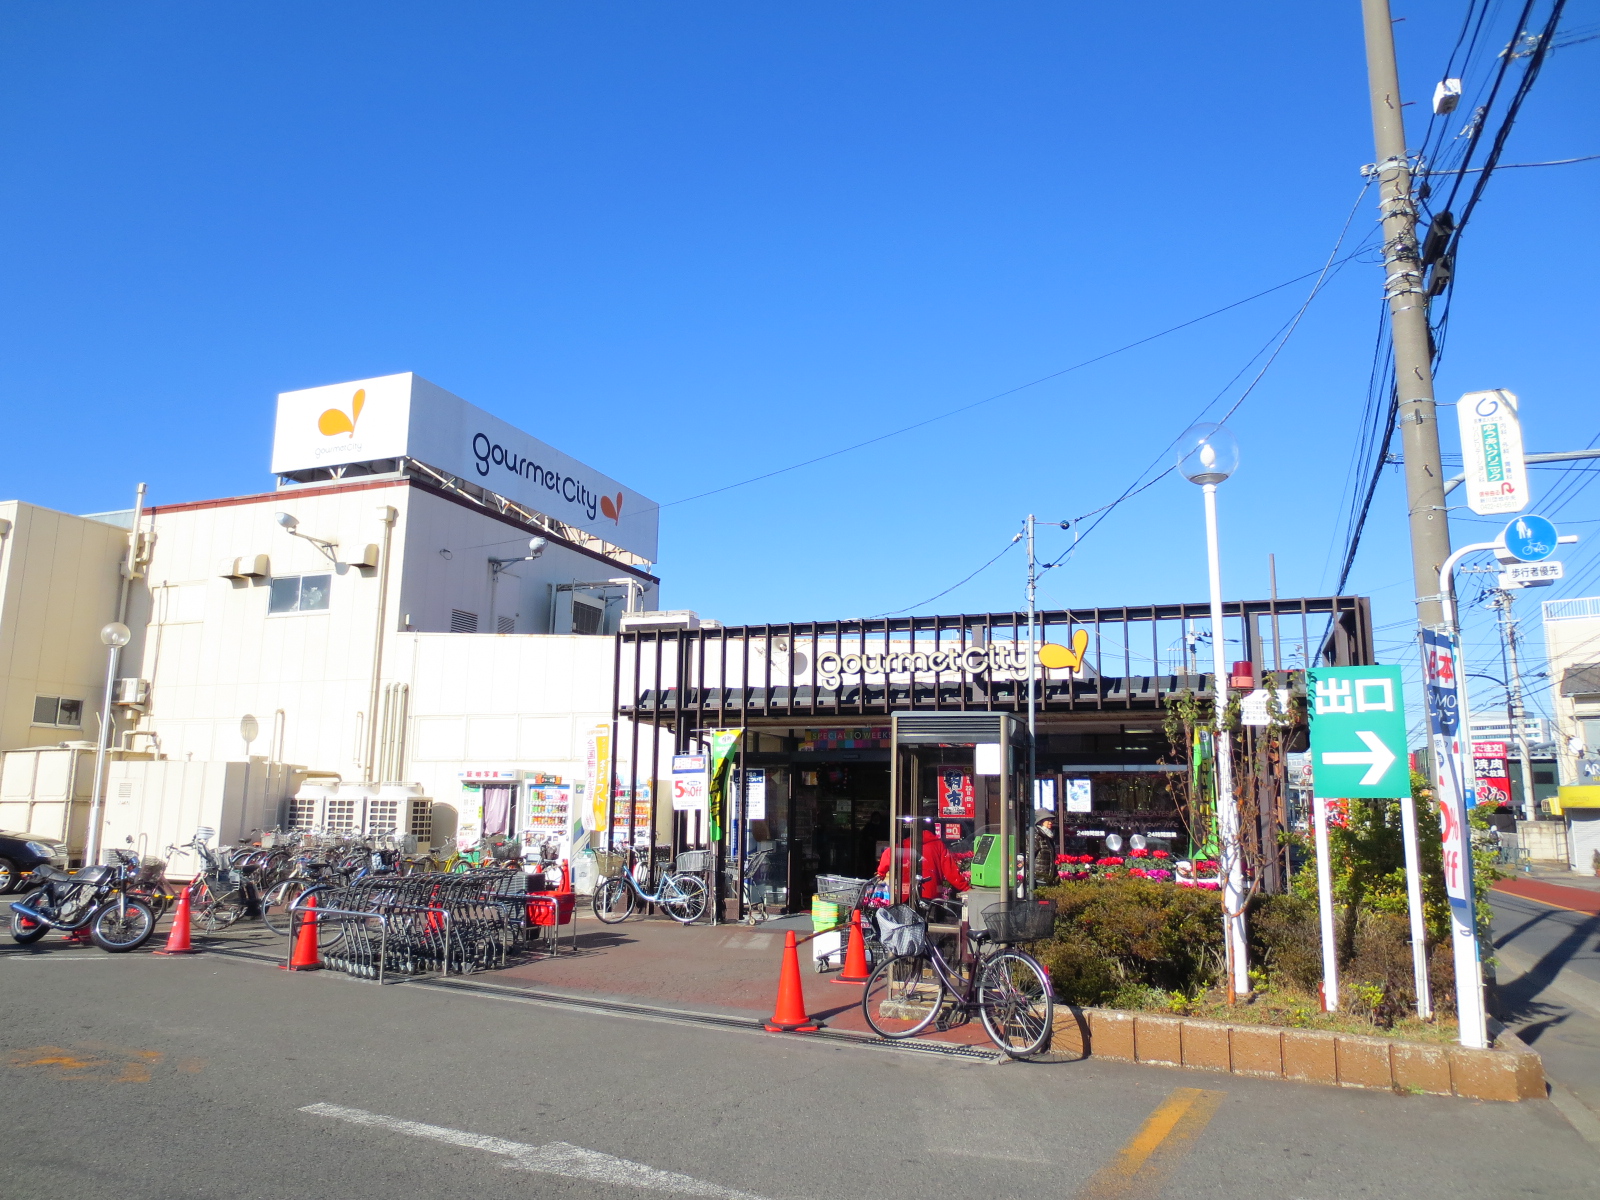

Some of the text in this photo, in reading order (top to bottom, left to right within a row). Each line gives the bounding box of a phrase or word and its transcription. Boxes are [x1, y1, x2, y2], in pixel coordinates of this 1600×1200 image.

[1511, 565, 1559, 579] 歩行者優先
[1315, 677, 1394, 715] 出口
[812, 732, 847, 740] SPECIAL
[1474, 758, 1504, 770] 焼肉
[466, 770, 499, 778] 証明写真
